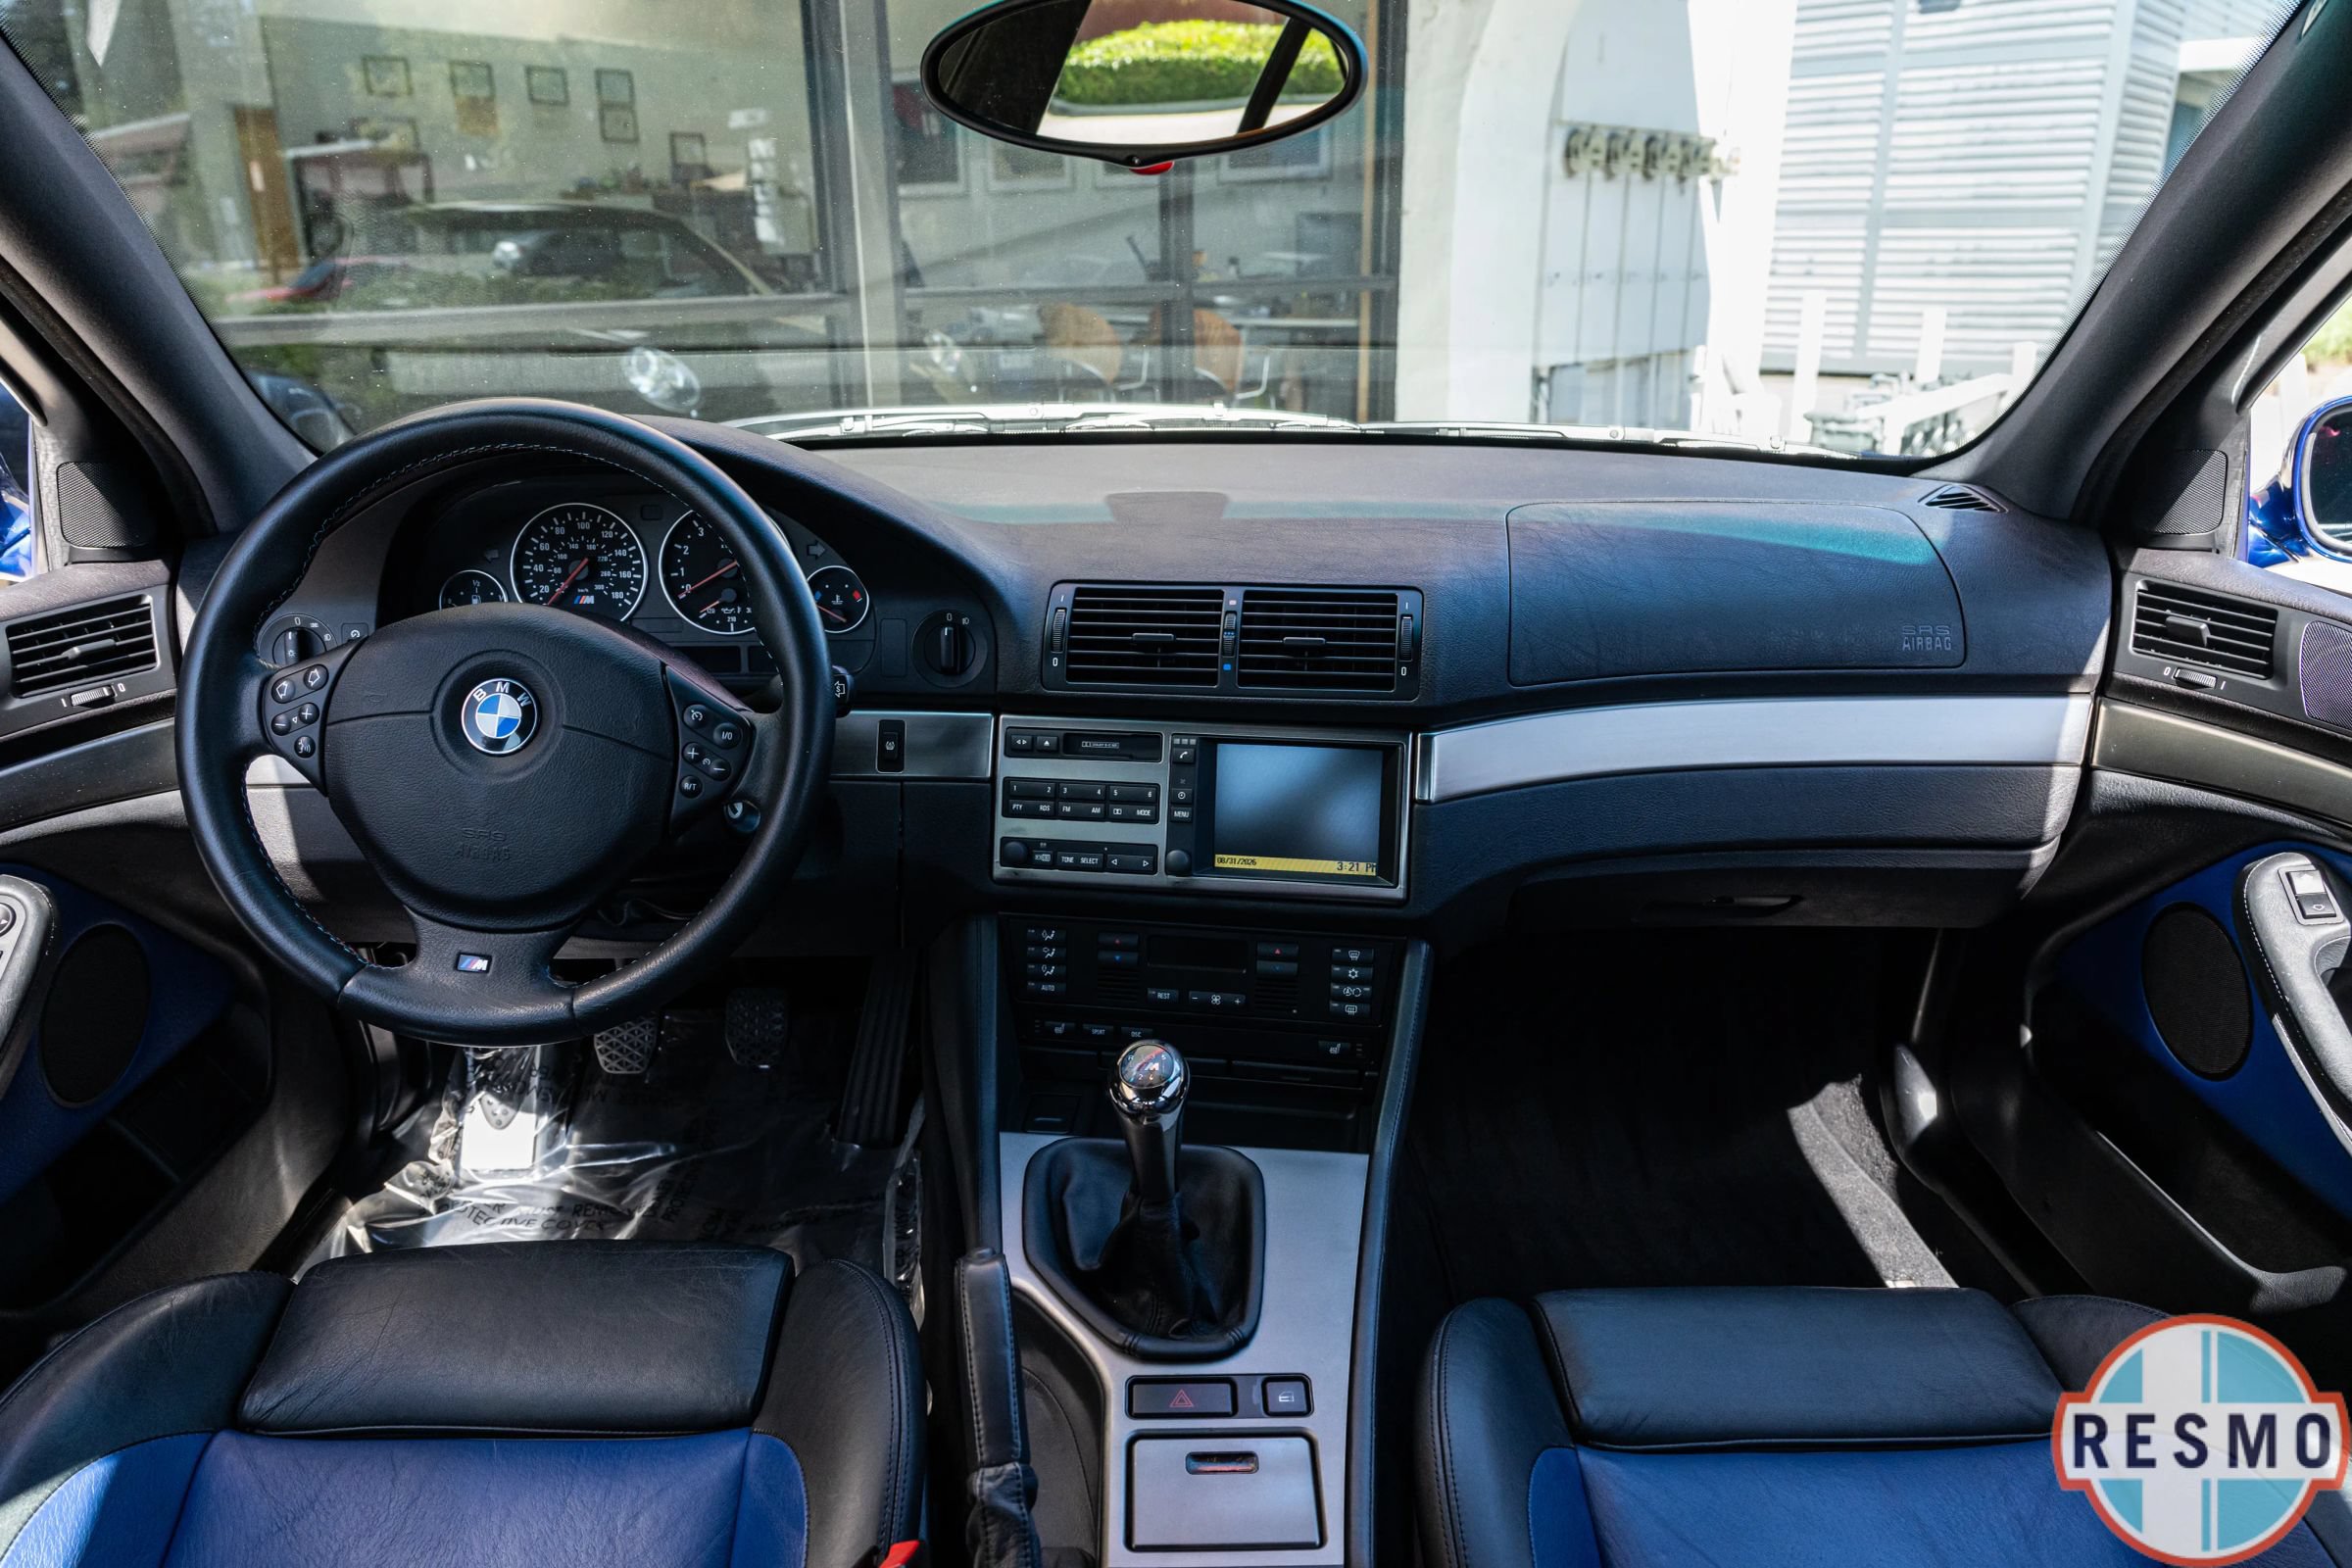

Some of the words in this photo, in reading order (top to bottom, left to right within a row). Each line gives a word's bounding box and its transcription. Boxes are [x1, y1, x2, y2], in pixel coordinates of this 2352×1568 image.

[698, 527, 705, 537] 3
[683, 545, 690, 555] 2
[533, 564, 544, 572] 40
[680, 567, 685, 576] 1
[1902, 624, 1950, 635] SRS
[1902, 637, 1951, 651] AIRBAG
[472, 681, 532, 707] BMW
[684, 782, 697, 791] R/T
[1216, 857, 1256, 866] 08/31/2026
[1337, 861, 1360, 872] 3:21
